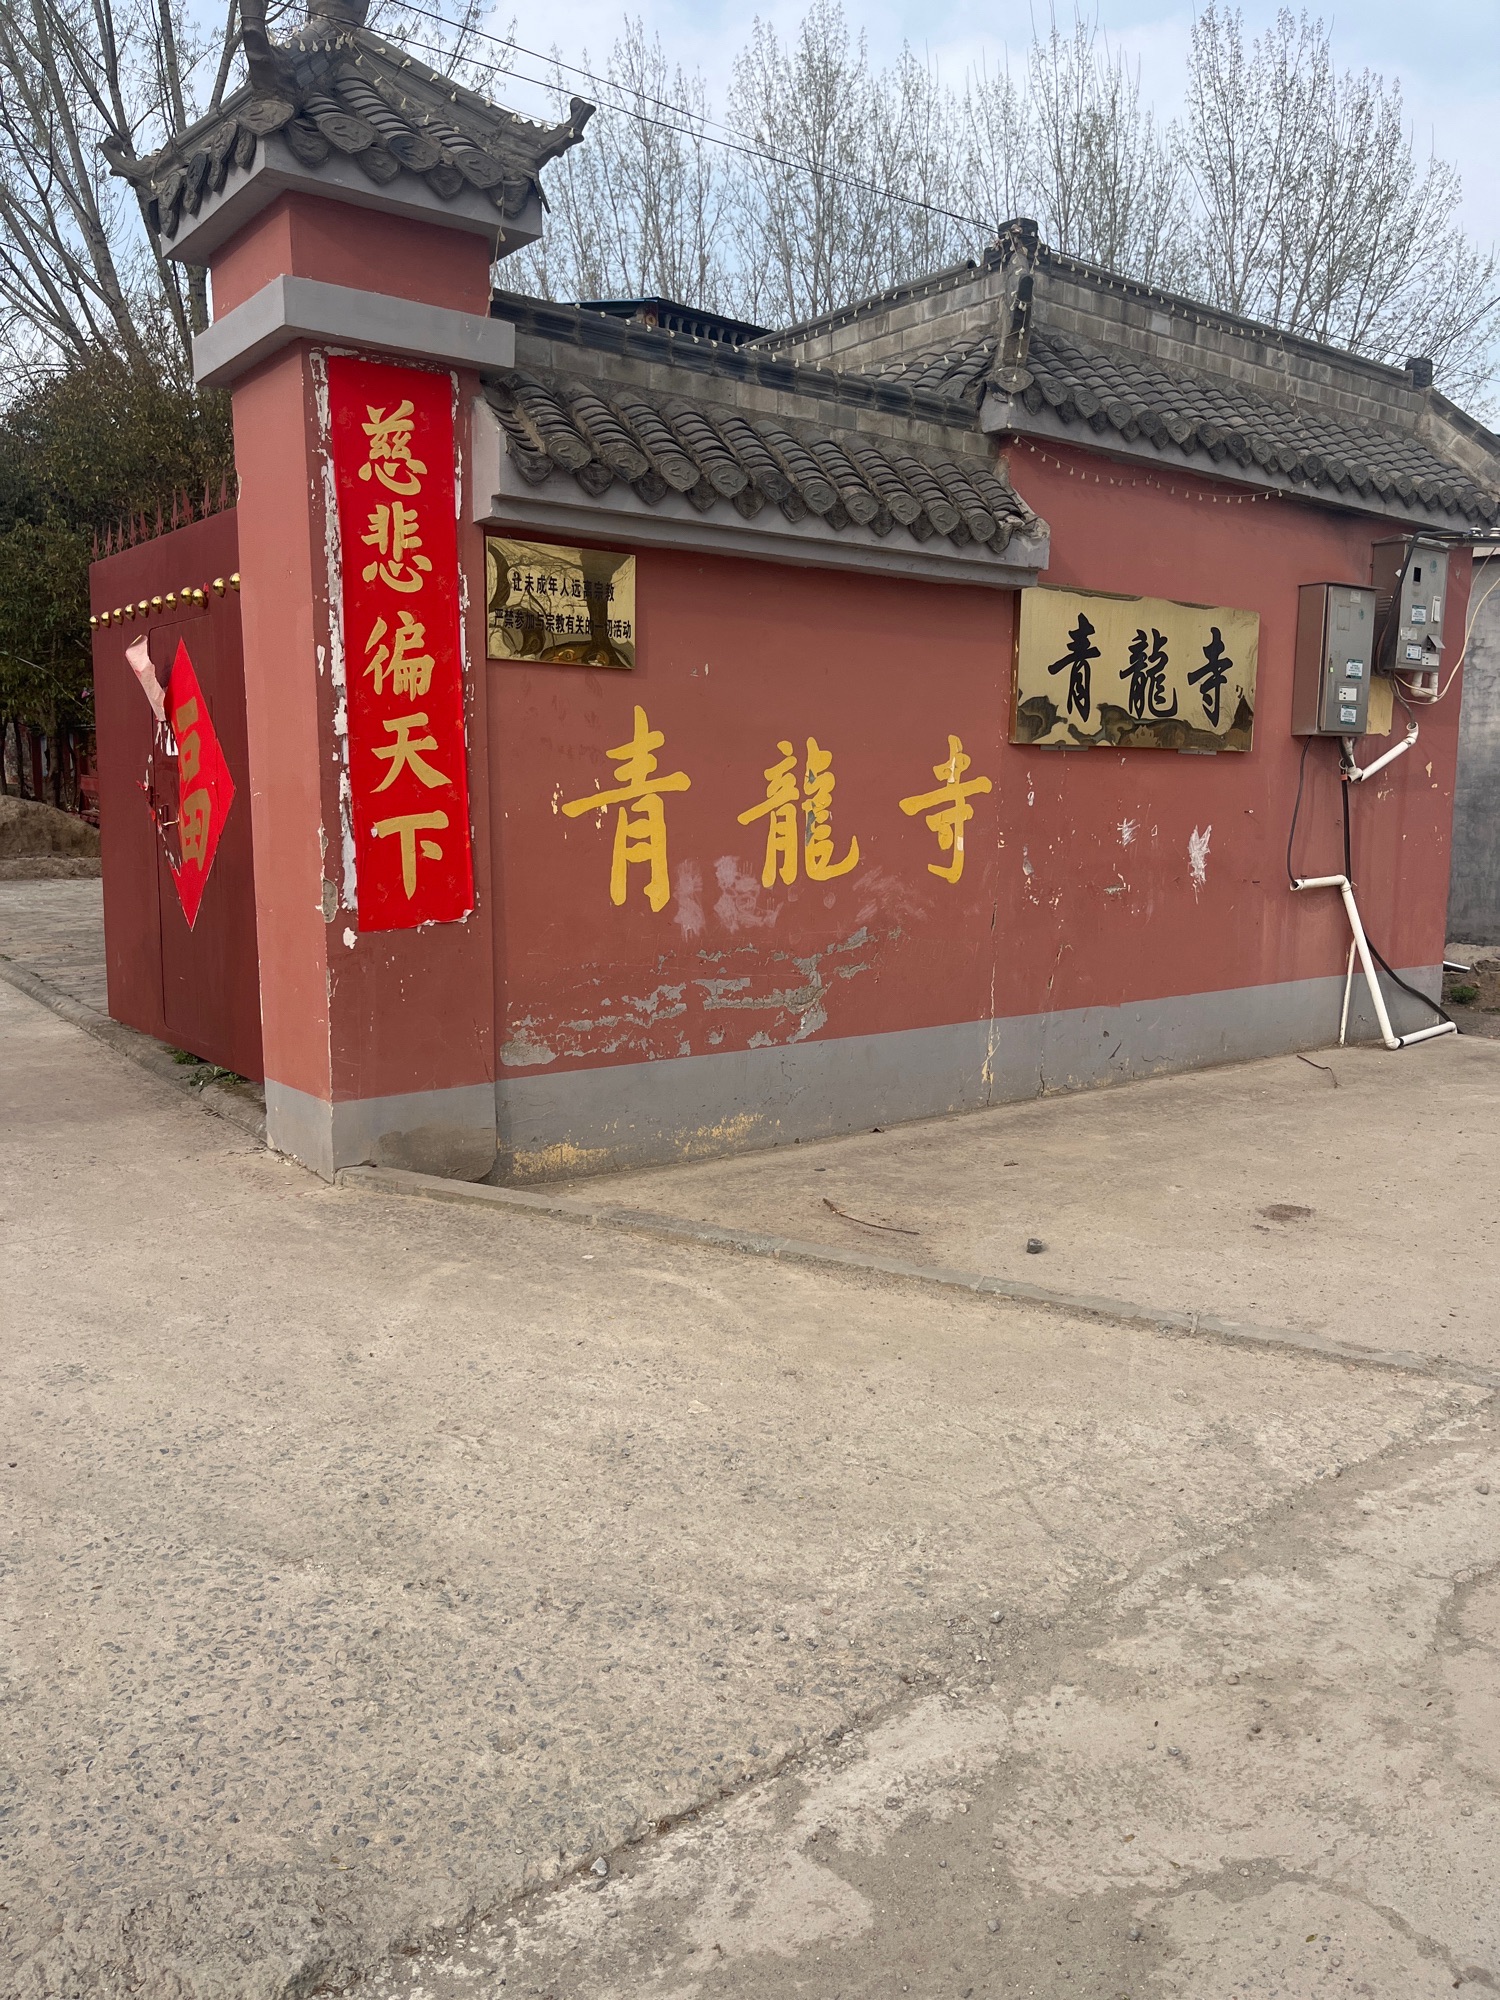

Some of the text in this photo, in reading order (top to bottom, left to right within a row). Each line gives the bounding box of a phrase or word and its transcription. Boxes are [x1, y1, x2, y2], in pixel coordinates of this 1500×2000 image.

[512, 571, 615, 602] 让未成年人远离宗教
